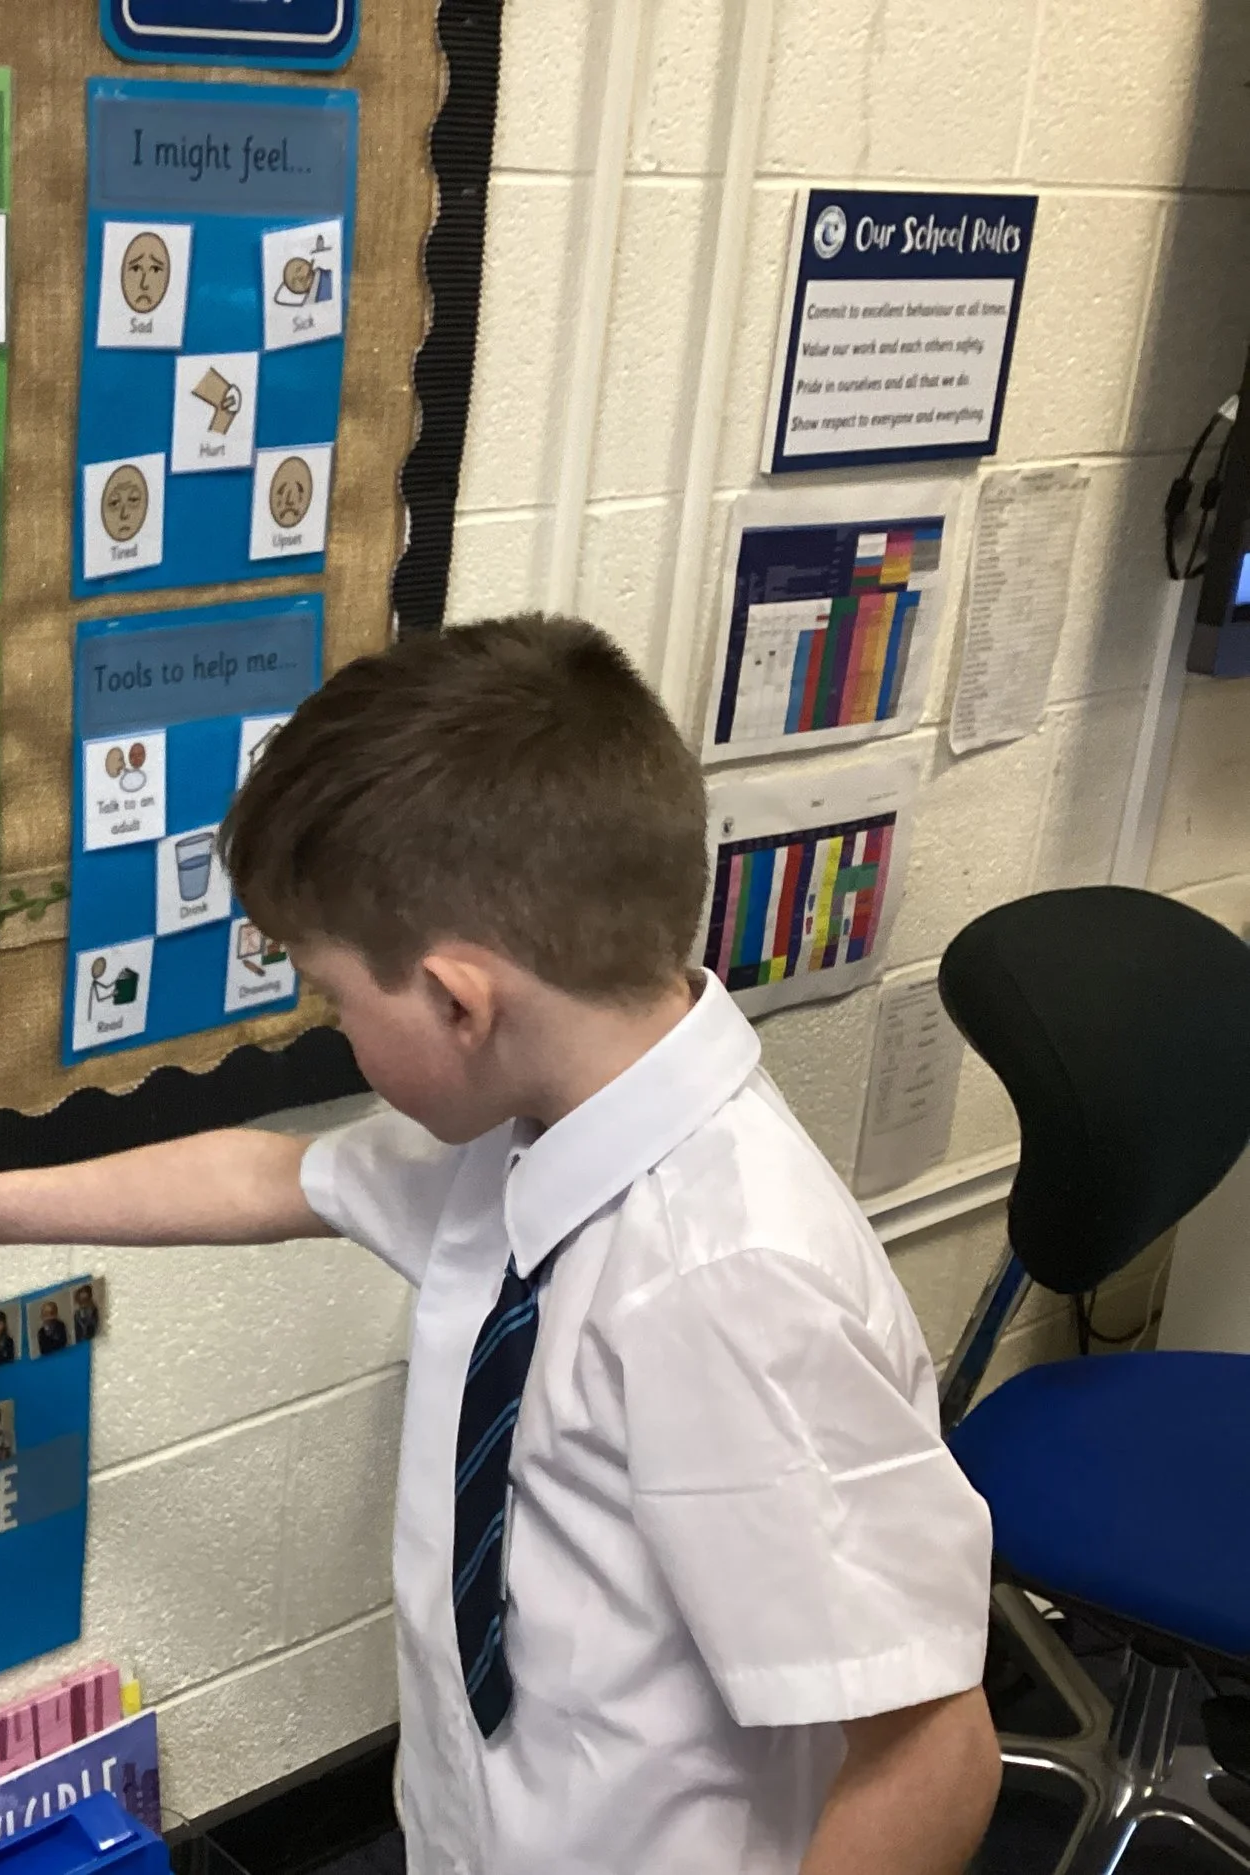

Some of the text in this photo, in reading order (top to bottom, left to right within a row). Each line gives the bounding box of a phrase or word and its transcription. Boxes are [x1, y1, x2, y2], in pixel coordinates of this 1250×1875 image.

[132, 128, 312, 183] I might feel...
[855, 213, 1021, 255] Our School Rules
[807, 303, 847, 319] Commit
[849, 305, 861, 319] to
[955, 304, 966, 317] at
[967, 301, 980, 316] all
[129, 318, 153, 334] Sad
[292, 315, 315, 331] Sick
[199, 443, 226, 457] Hurt
[272, 533, 302, 550] Upset
[110, 544, 138, 561] Tired
[94, 650, 298, 694] Tools to help me...
[111, 819, 141, 835] adult
[180, 901, 208, 919] Drink
[239, 980, 281, 999] Drawing
[96, 1016, 123, 1034] Read
